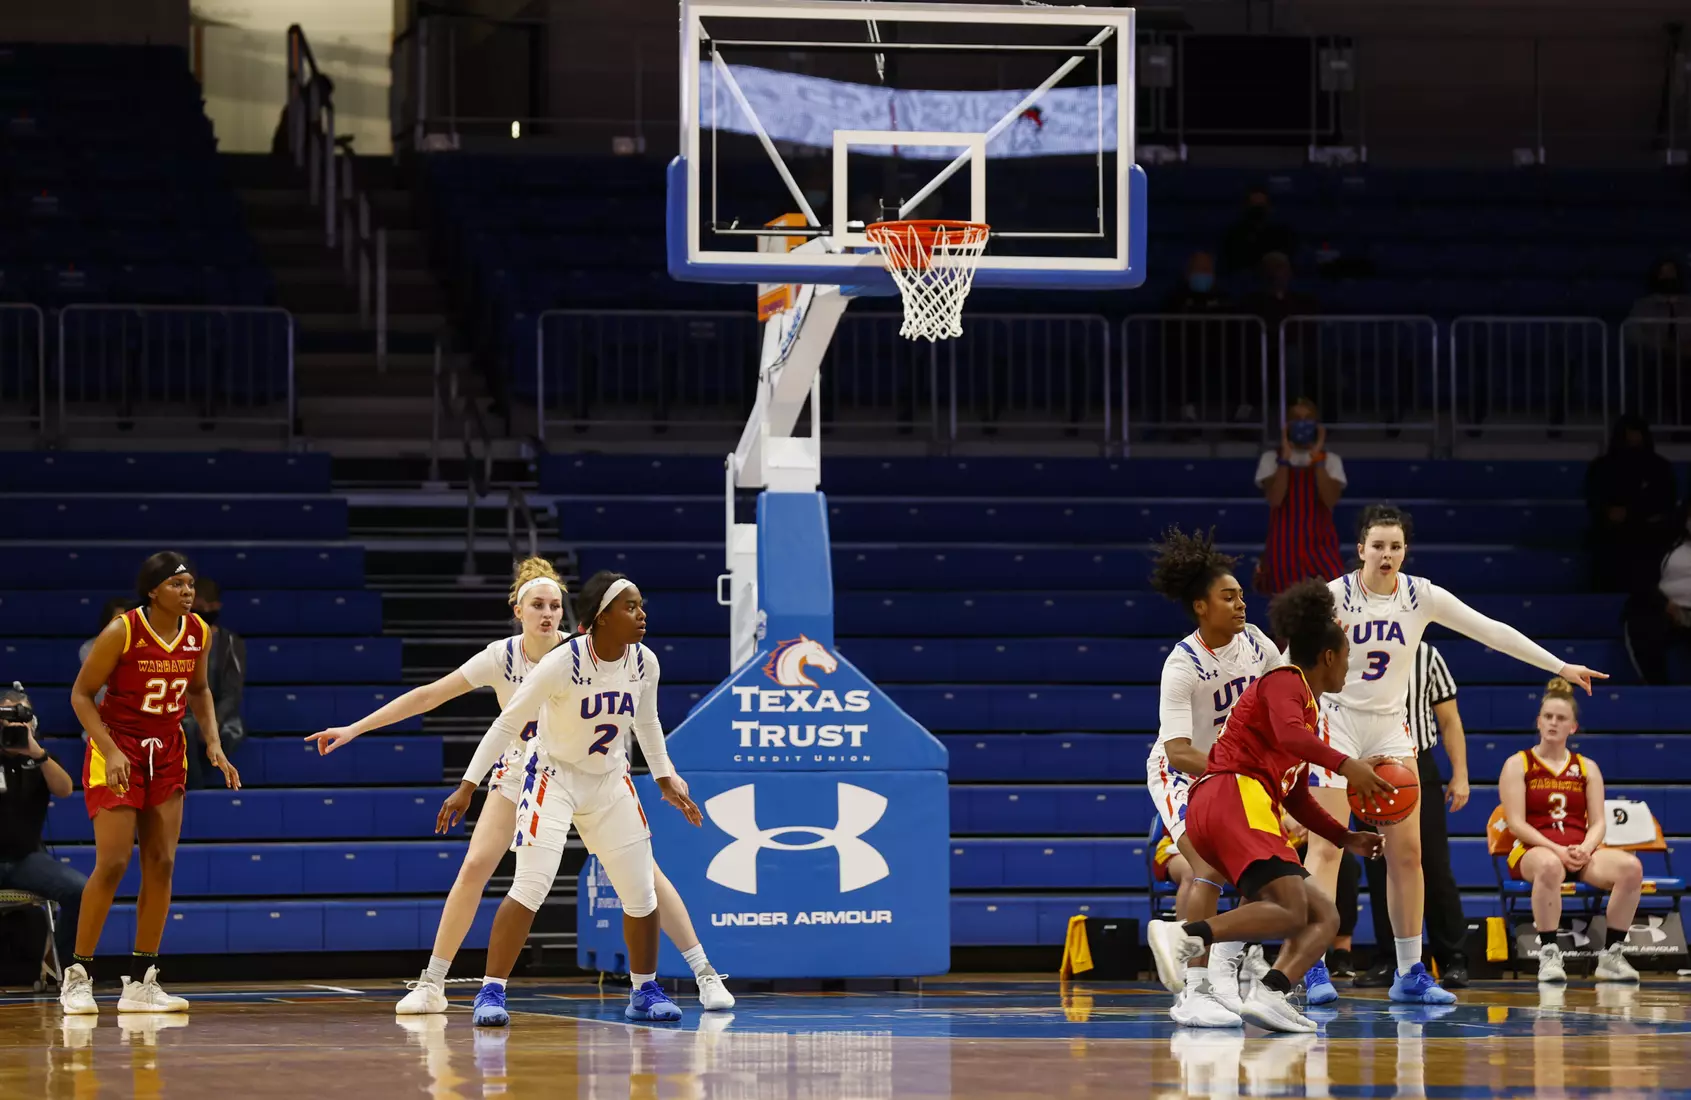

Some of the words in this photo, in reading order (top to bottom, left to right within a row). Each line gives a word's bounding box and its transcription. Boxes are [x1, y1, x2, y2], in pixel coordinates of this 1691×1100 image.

[1353, 620, 1406, 646] UTA
[1361, 650, 1391, 681] 3
[141, 677, 188, 715] 23
[580, 691, 635, 720] UTA
[732, 685, 871, 713] TEXAS
[588, 723, 619, 756] 2
[732, 720, 869, 748] TRUST
[733, 754, 802, 763] CREDIT
[814, 754, 871, 763] UNION
[1548, 791, 1568, 821] 3
[711, 912, 788, 927] UNDER
[793, 910, 892, 926] ARMOUR
